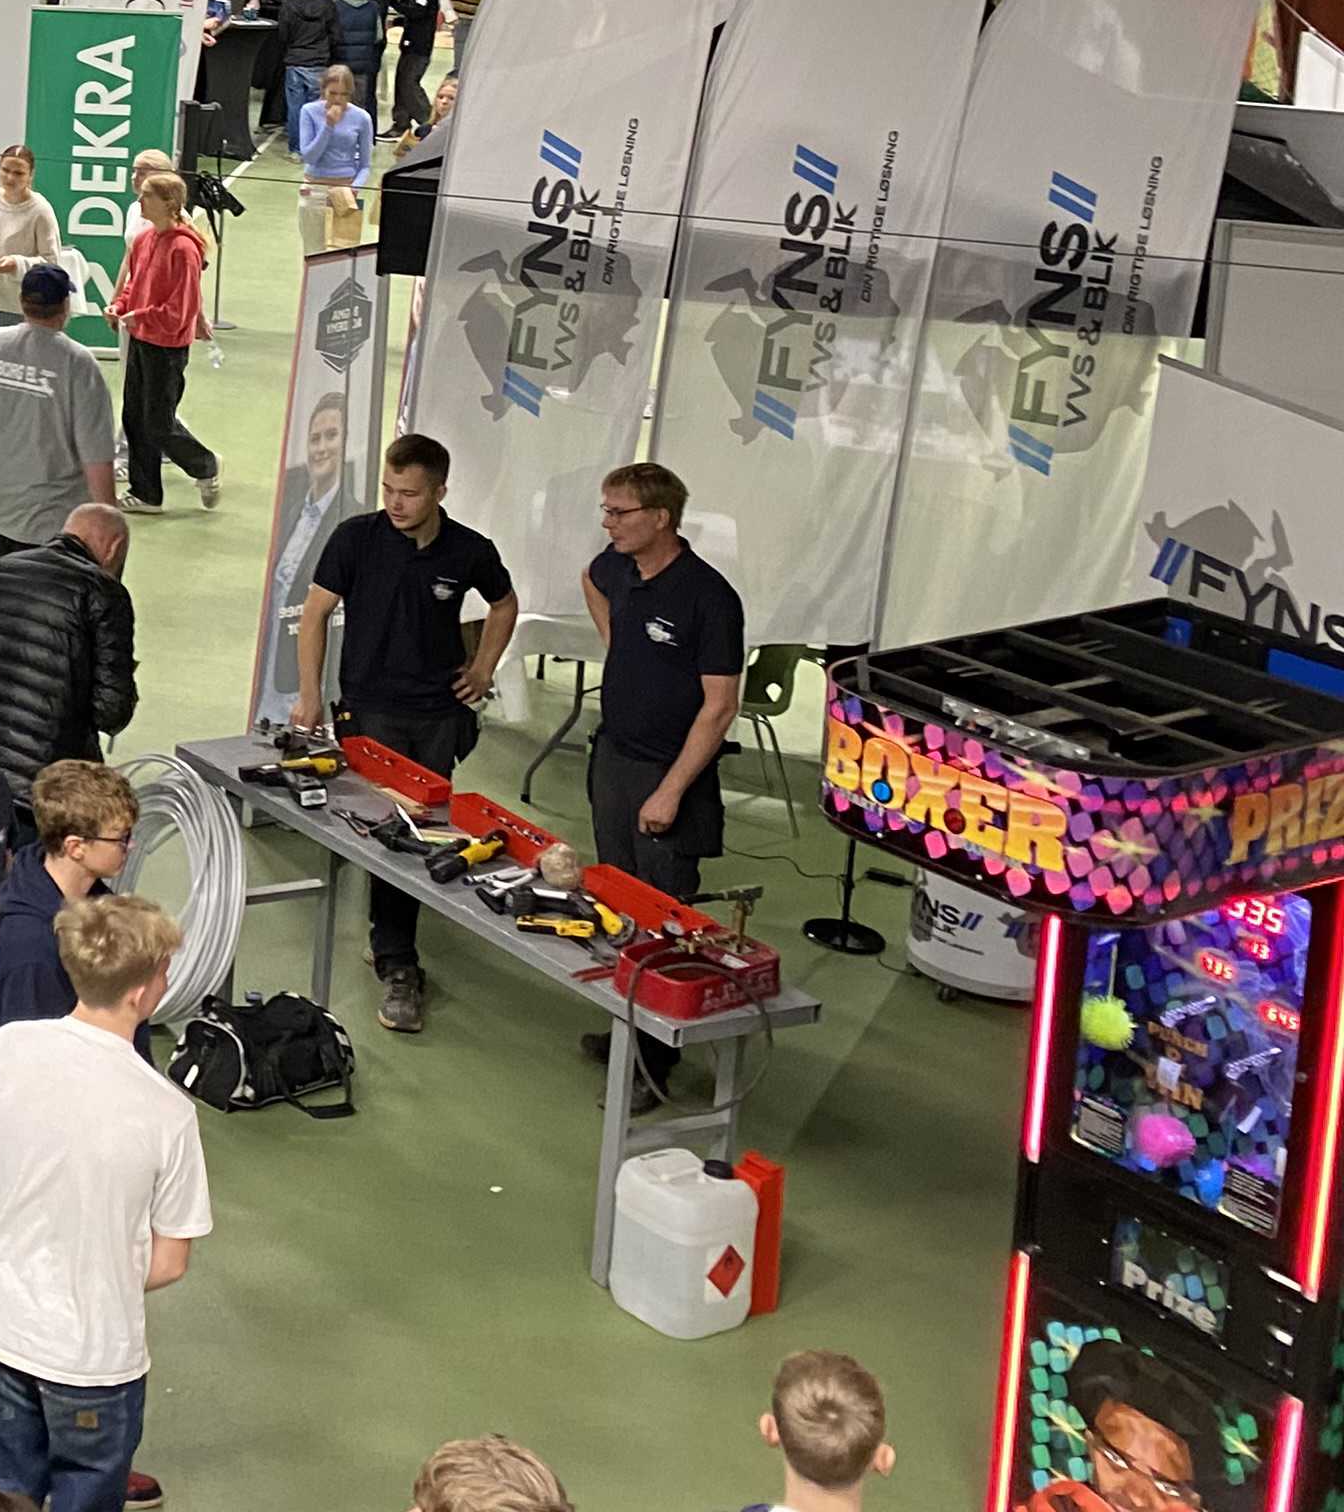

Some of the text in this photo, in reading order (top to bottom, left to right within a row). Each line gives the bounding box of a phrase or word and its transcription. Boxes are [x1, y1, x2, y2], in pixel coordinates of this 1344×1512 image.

[67, 34, 136, 237] DEKRA
[602, 256, 616, 285] DIN
[620, 117, 639, 187] LØSNING
[861, 129, 900, 304] DIN RIGTIGE LØSNING
[507, 176, 575, 370] FYNS
[551, 185, 601, 371] VVS & BLIK
[757, 191, 831, 392] FYNS
[805, 201, 858, 393] VVS & BLIK
[1010, 220, 1090, 427] FYNS
[1062, 228, 1119, 428] VVS & BLIK
[1122, 155, 1163, 336] DIN RIGTIGE LØSNING
[824, 718, 1068, 874] BOXER
[1266, 1007, 1300, 1031] 645
